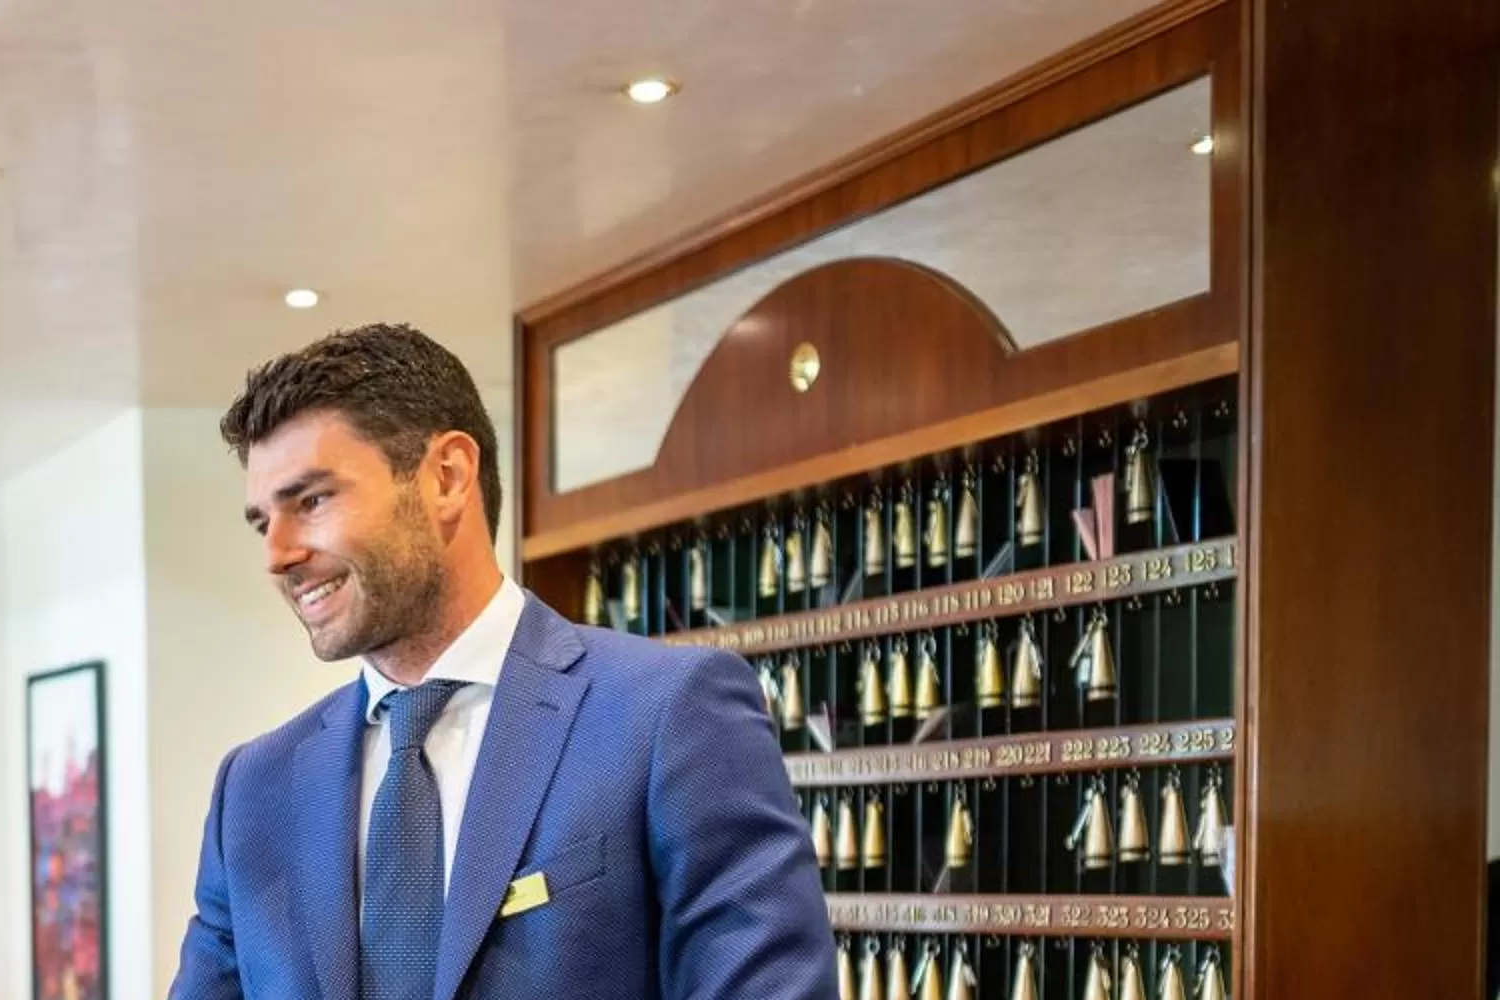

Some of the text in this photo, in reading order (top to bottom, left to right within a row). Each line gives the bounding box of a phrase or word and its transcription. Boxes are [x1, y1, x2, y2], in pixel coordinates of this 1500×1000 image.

[876, 602, 899, 625] 115
[904, 600, 928, 620] 116
[934, 595, 959, 615] 118
[966, 588, 991, 610] 119
[999, 583, 1024, 605] 120
[1030, 577, 1054, 599] 121
[1066, 571, 1094, 594] 122
[1103, 563, 1132, 587] 123
[1143, 557, 1173, 580] 124
[1184, 548, 1216, 573] 125
[963, 748, 991, 769] 219
[998, 742, 1024, 766] 220
[1024, 742, 1051, 767] 221
[1063, 738, 1093, 762] 222
[1096, 735, 1132, 759] 223
[1140, 731, 1172, 755] 224
[1176, 727, 1215, 752] 225
[964, 902, 990, 924] 319
[992, 903, 1022, 926] 320
[1025, 904, 1050, 928] 321
[1061, 904, 1092, 928] 322
[1097, 905, 1130, 928] 323
[1135, 905, 1169, 928] 324
[1175, 906, 1211, 929] 325
